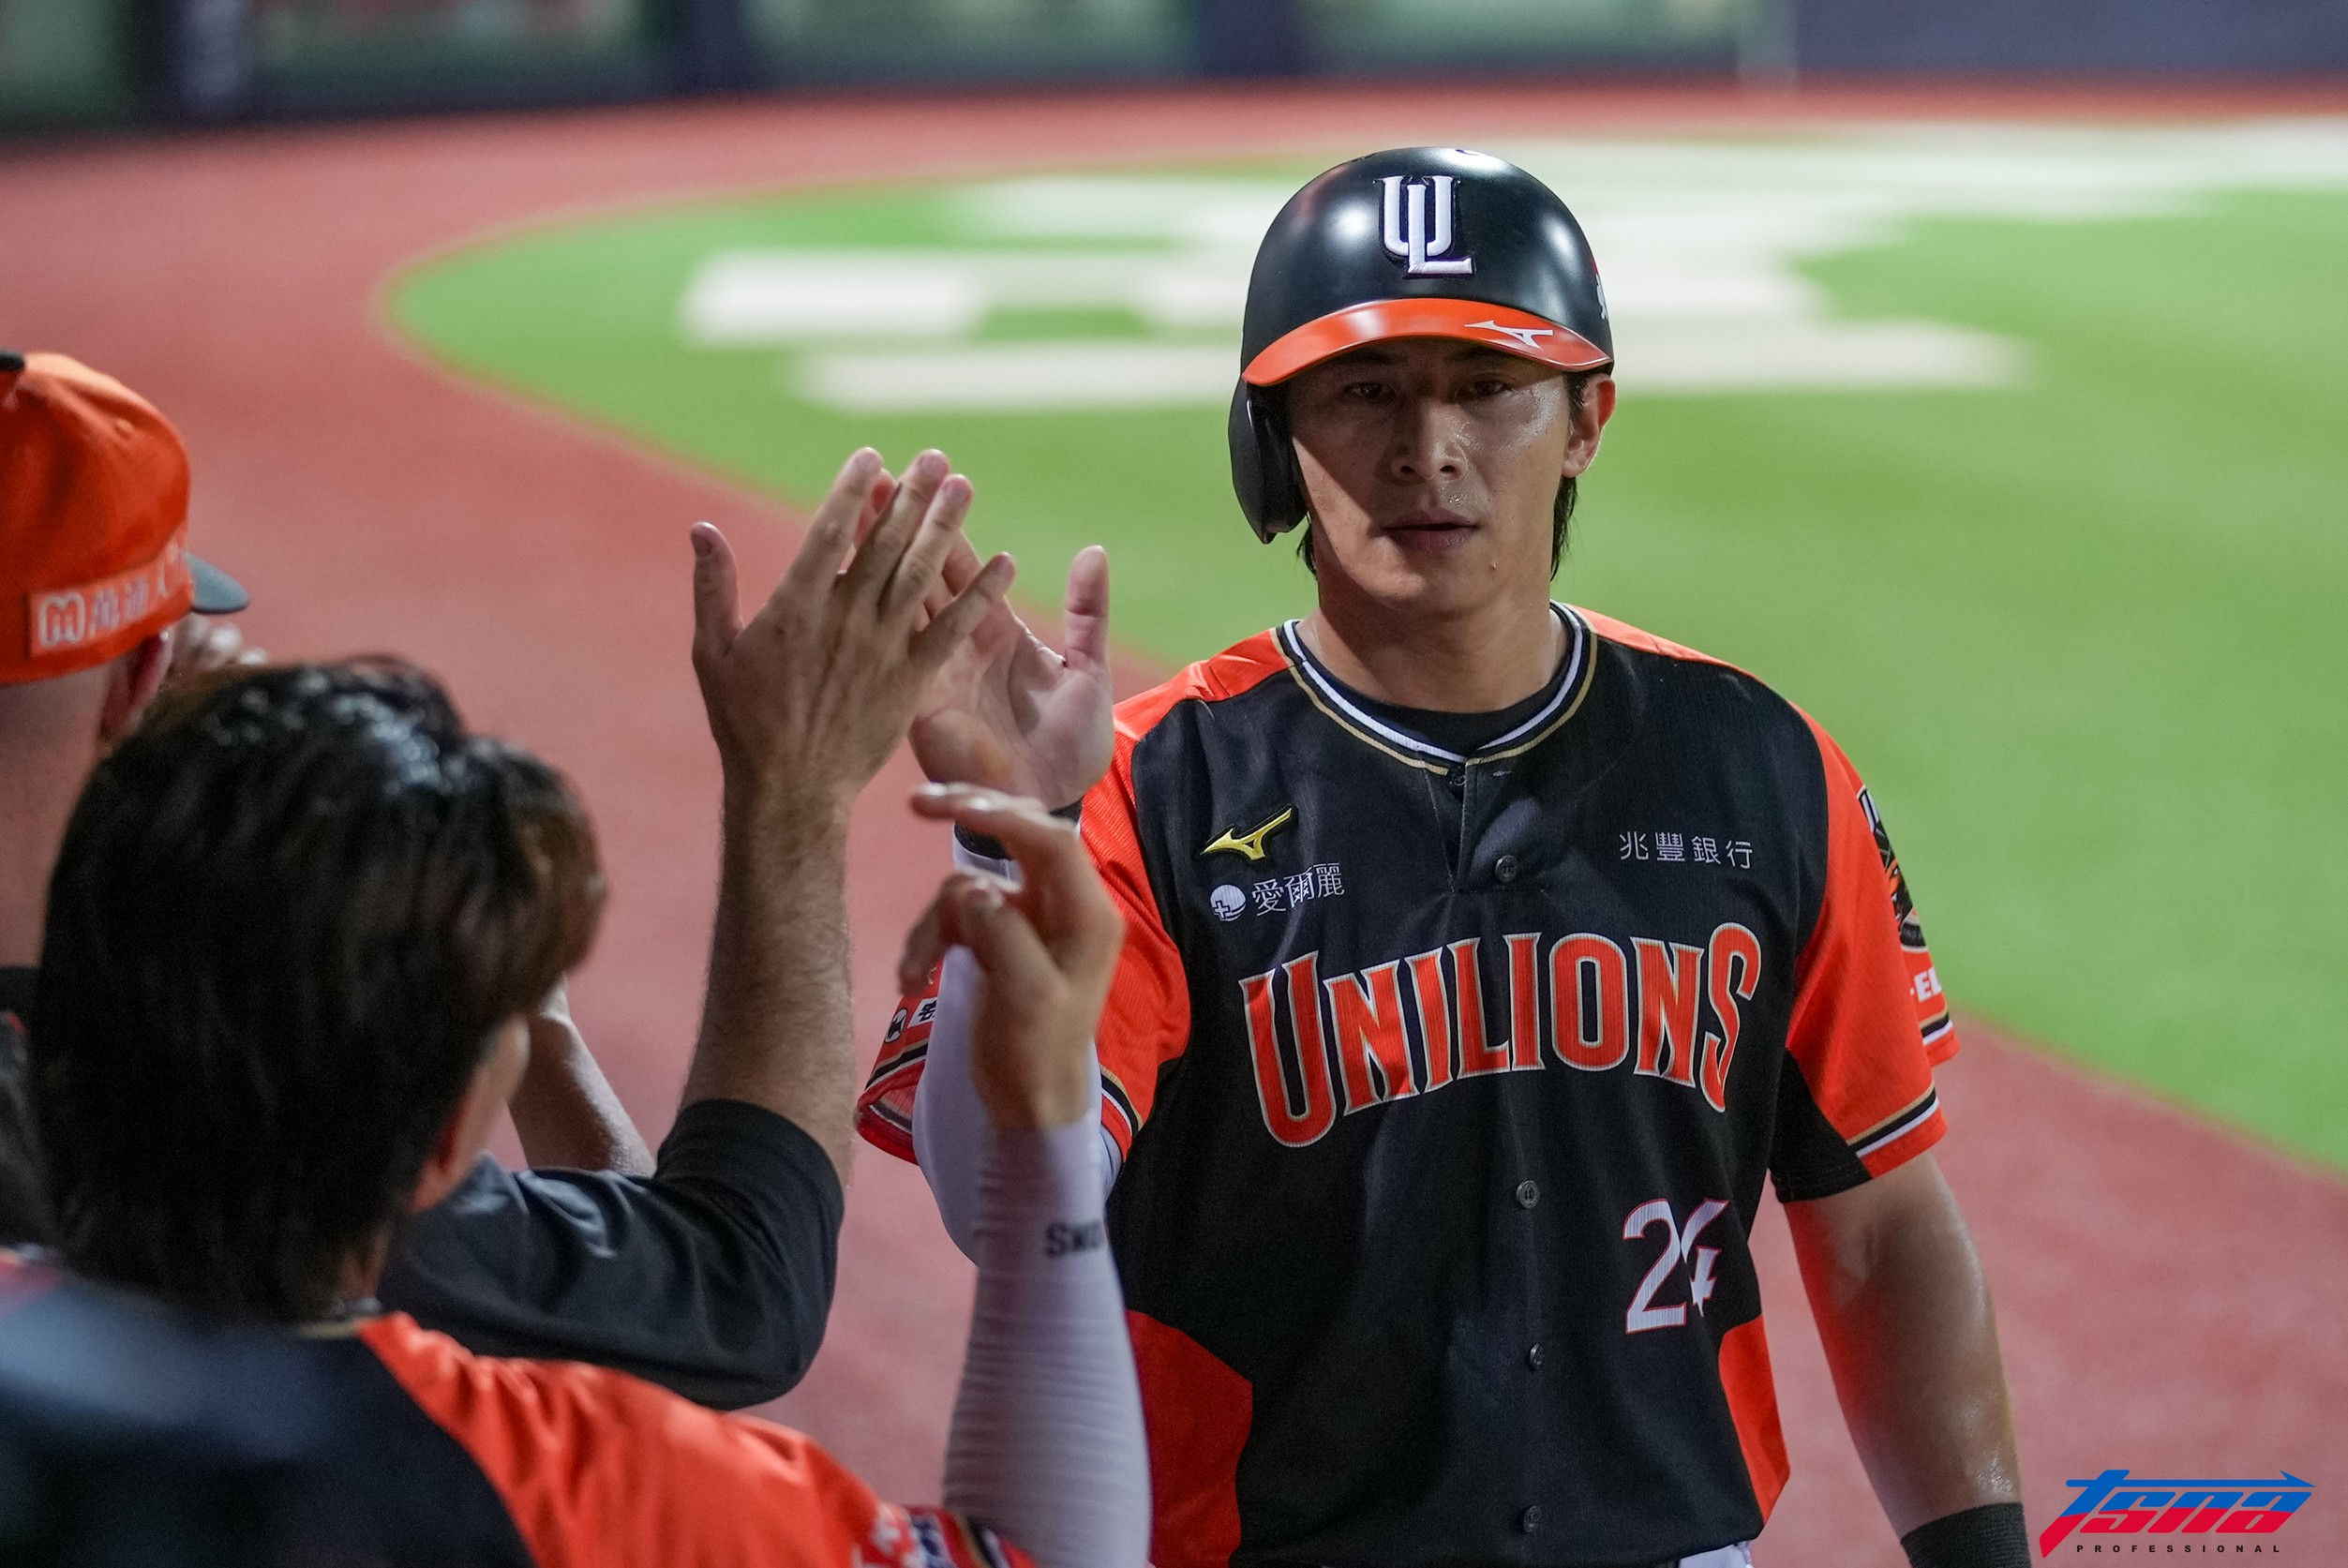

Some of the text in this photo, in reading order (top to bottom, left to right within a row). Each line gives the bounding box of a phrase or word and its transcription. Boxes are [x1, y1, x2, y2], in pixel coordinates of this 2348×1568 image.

[1620, 830, 1753, 870] 兆豐銀行
[1251, 862, 1345, 917] 愛爾麗
[1238, 922, 1761, 1148] UNILIONS
